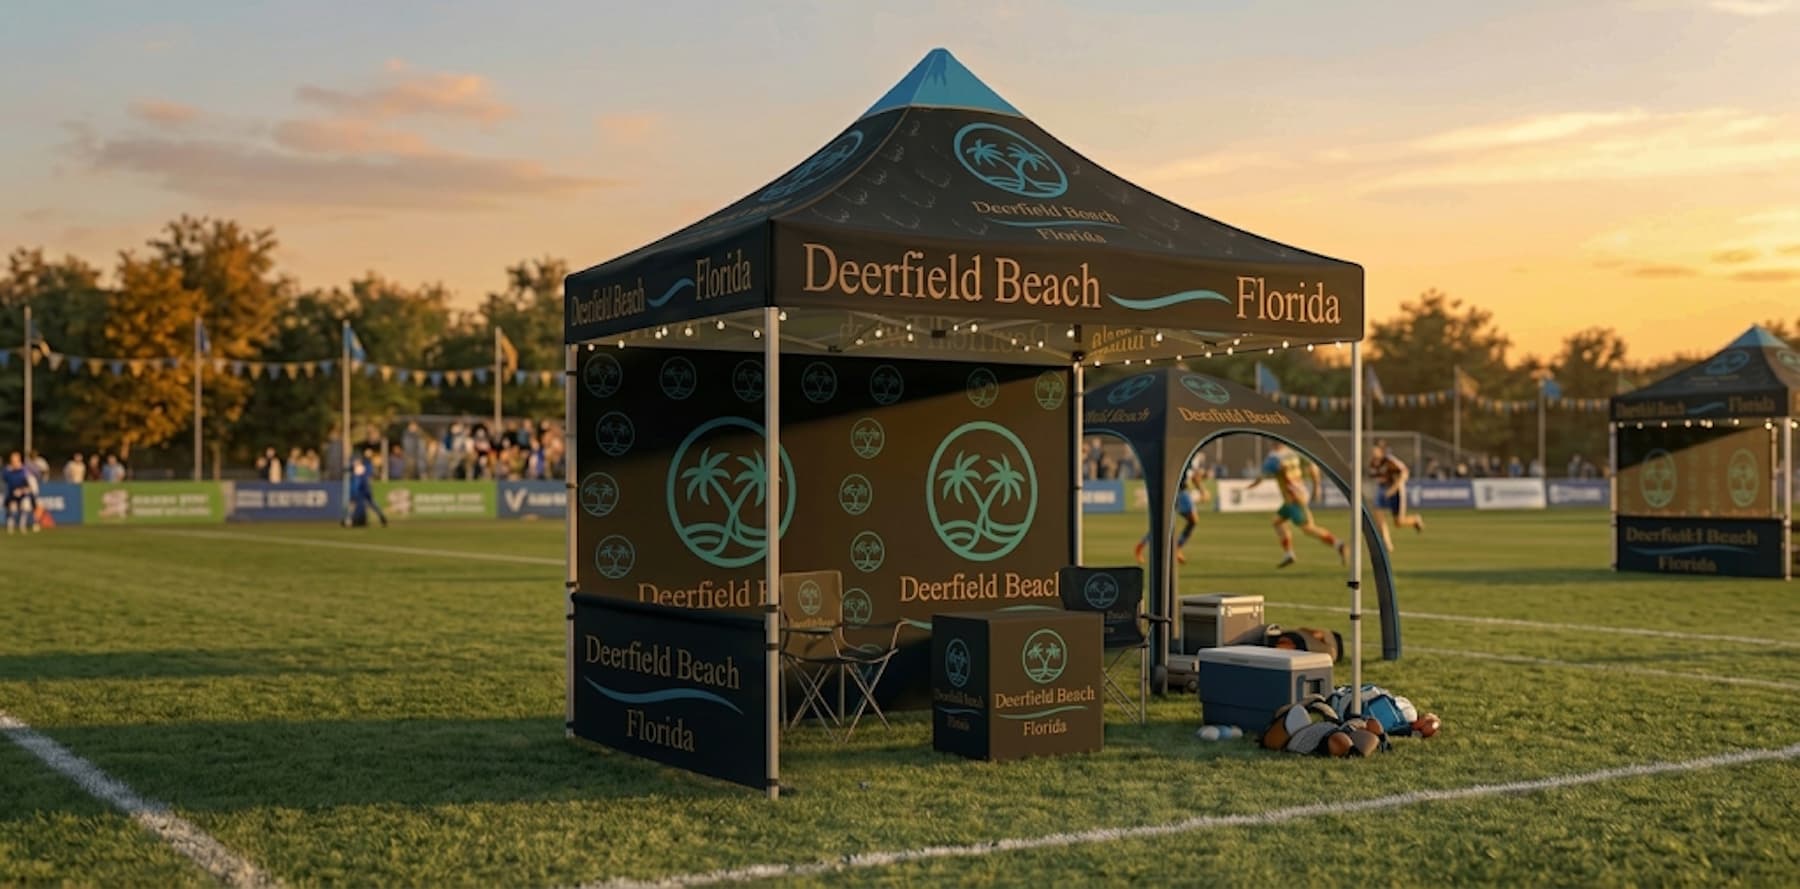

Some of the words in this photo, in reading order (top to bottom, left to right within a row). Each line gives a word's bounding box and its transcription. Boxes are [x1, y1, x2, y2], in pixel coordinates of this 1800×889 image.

[972, 200, 1062, 218] Deerfield
[613, 277, 645, 317] Beach
[695, 249, 752, 301] Florida
[802, 243, 984, 301] Deerfield
[994, 256, 1102, 309] Beach
[1236, 275, 1342, 325] Florida
[637, 579, 751, 609] Deerfield
[900, 572, 999, 602] Deerfield
[585, 634, 672, 678] Deerfield
[676, 648, 742, 690] Beach
[994, 687, 1054, 710] Deerfield
[1056, 685, 1096, 703] Beach
[625, 708, 696, 752] Florida
[1022, 718, 1068, 737] Florida
